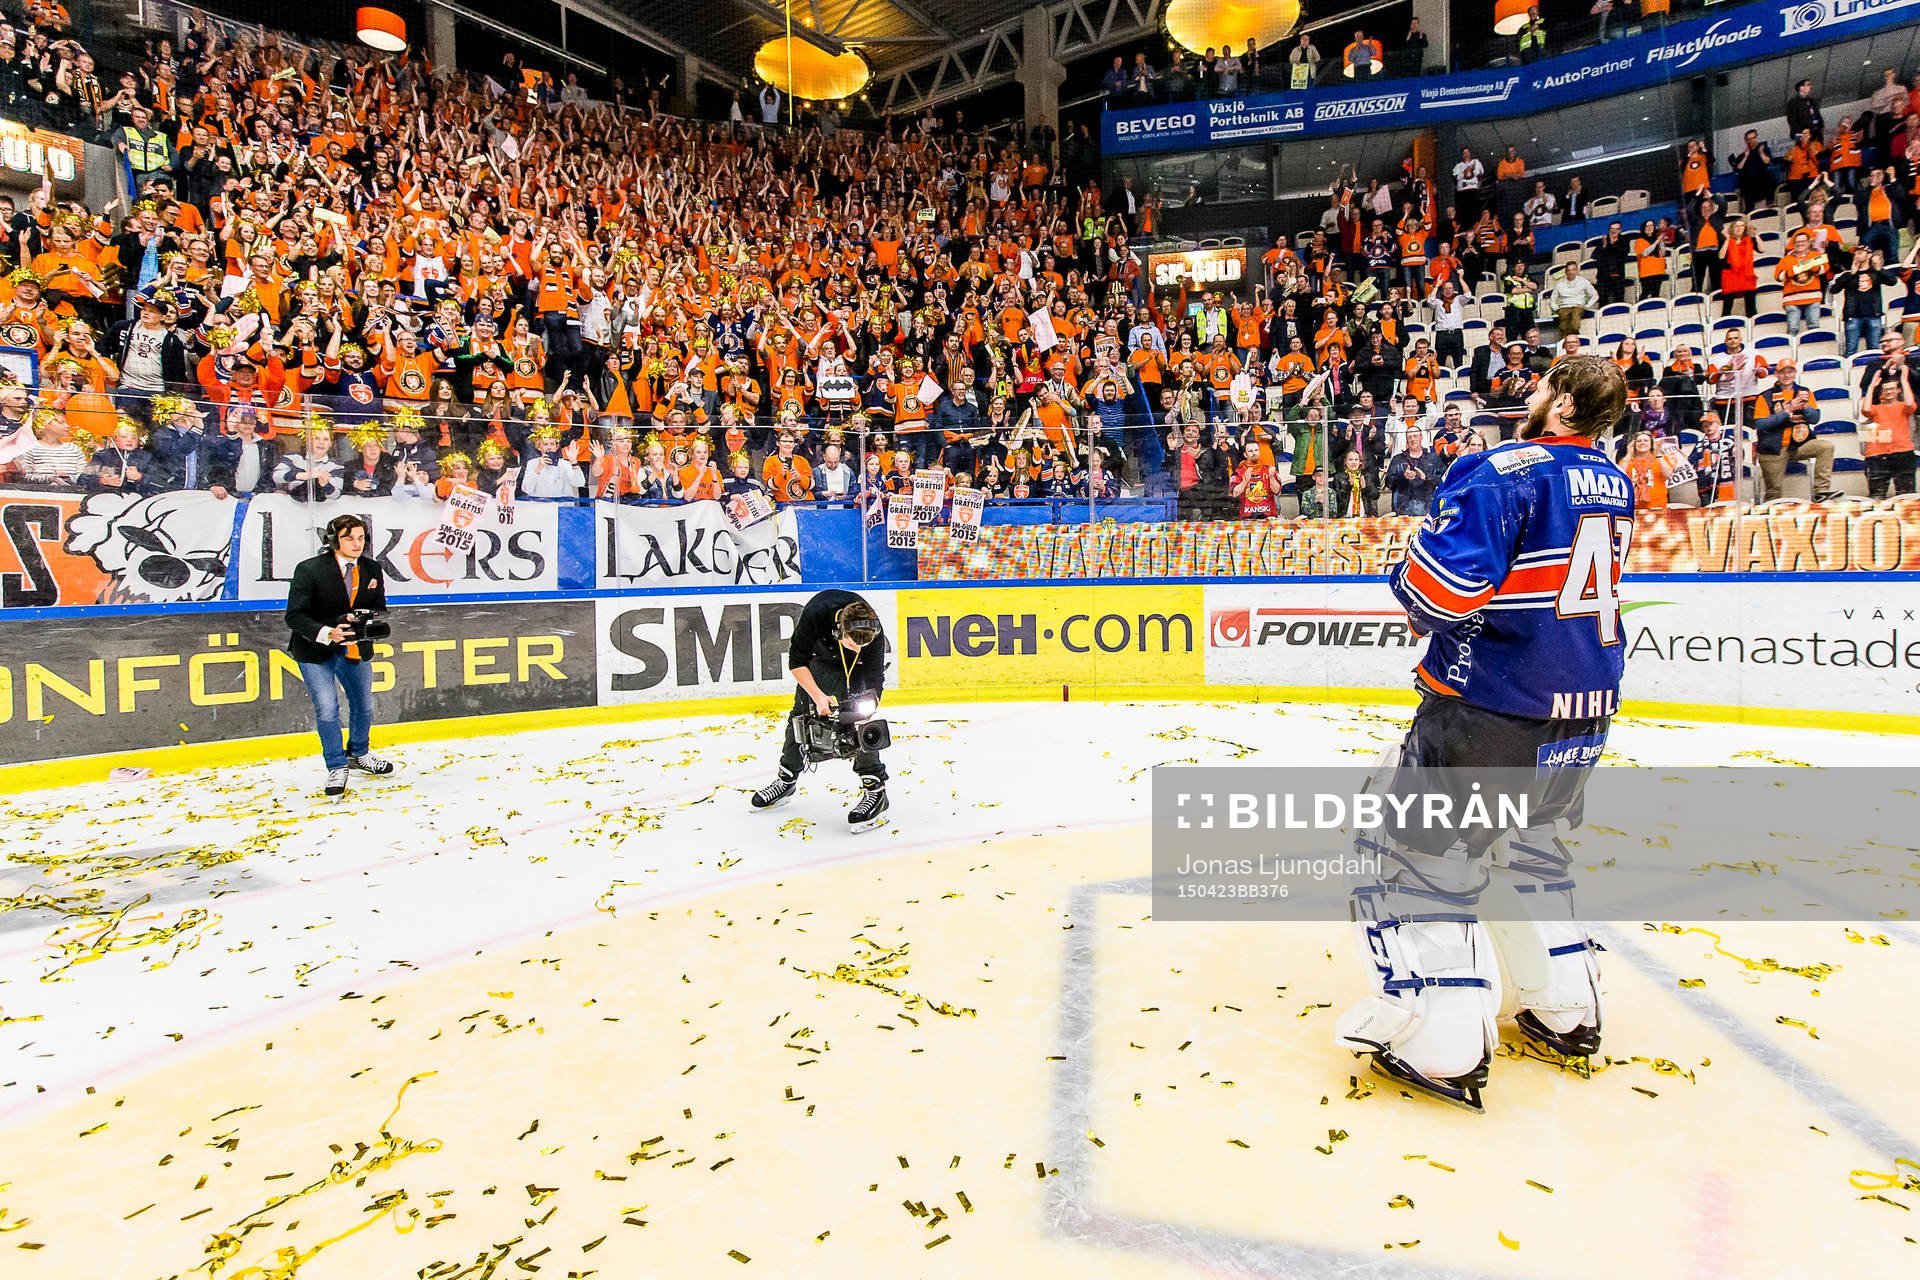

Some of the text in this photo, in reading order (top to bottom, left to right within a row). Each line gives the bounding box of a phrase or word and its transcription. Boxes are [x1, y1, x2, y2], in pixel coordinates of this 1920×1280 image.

[1543, 57, 1635, 90] AutoPartner
[1209, 101, 1245, 114] Växjö
[1210, 107, 1304, 127] Portteknik AB
[1314, 96, 1407, 119] GÖRANSSON
[1116, 114, 1196, 134] BEVEGO
[1567, 468, 1629, 499] MAXI
[1667, 470, 1694, 486] 2015
[439, 523, 474, 541] SM-GULD
[950, 529, 976, 541] 2015
[951, 522, 978, 532] SM-GULD
[1685, 502, 1902, 572] VÄXJÖ
[256, 511, 544, 588] LKERS
[435, 531, 472, 551] 2015
[889, 537, 916, 547] 2015
[1550, 689, 1621, 719] NIHL
